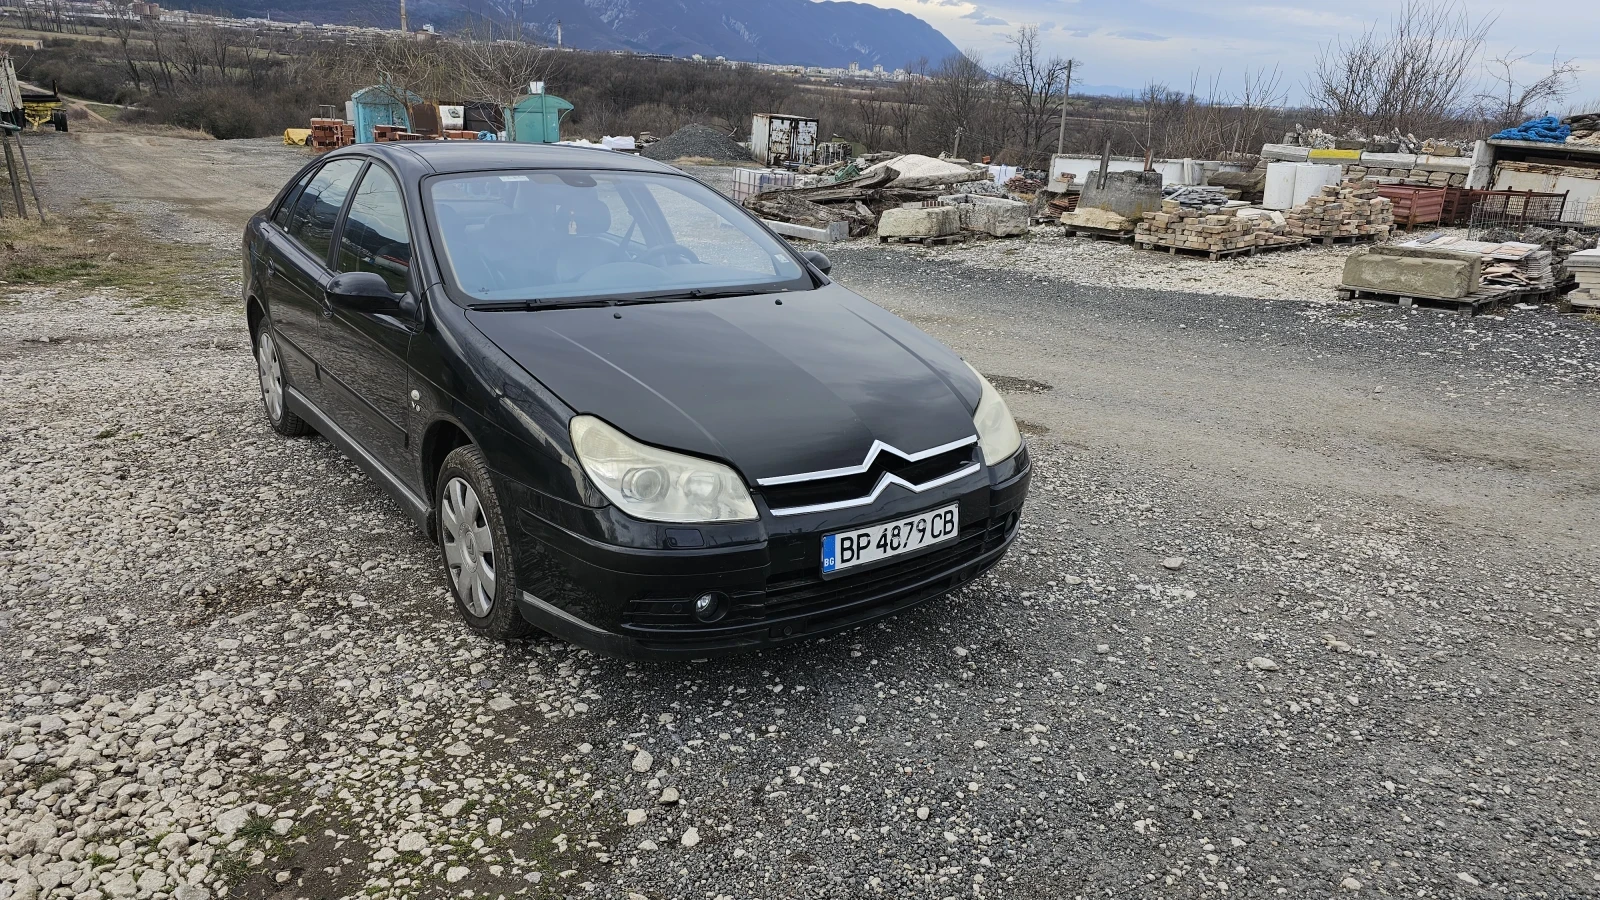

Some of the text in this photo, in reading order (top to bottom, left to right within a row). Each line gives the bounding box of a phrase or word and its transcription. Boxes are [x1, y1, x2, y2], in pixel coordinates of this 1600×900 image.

[840, 509, 955, 564] BP 4879 CB
[824, 558, 835, 567] BG
